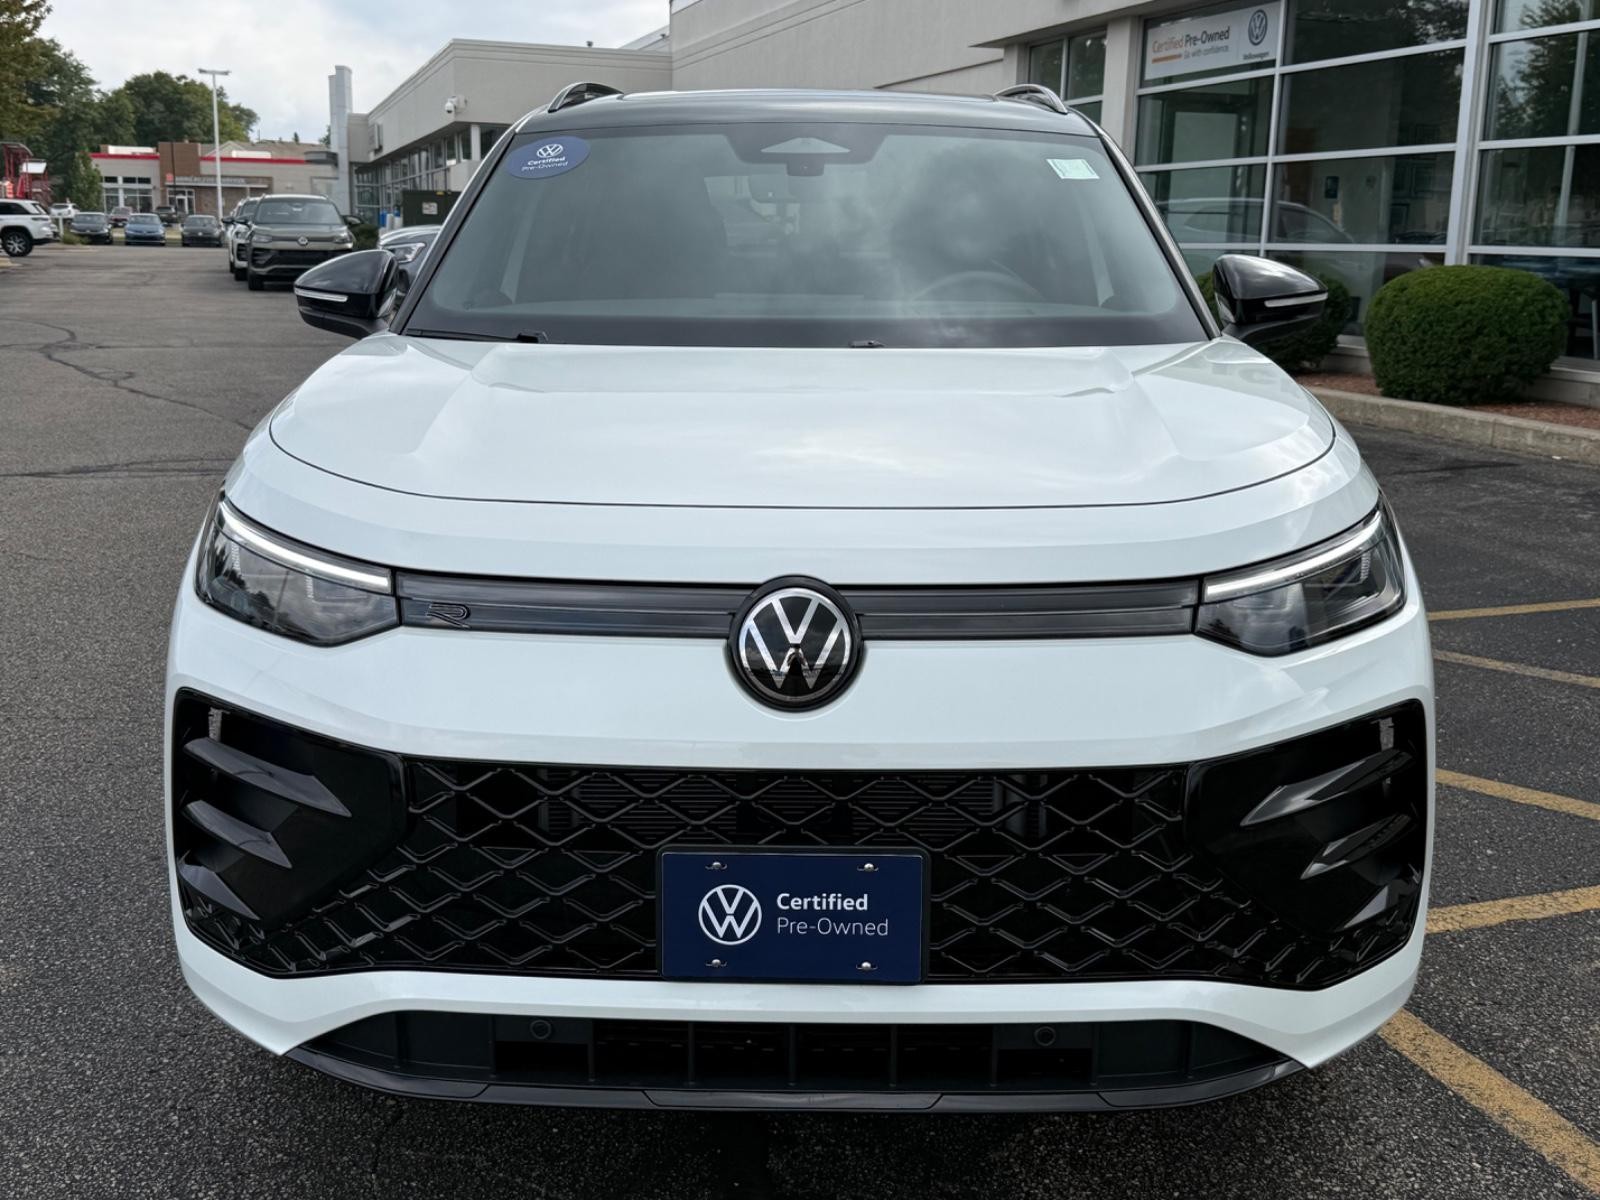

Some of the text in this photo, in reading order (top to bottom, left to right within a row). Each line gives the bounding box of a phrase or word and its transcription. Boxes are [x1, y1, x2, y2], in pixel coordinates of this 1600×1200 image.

[1152, 26, 1230, 54] Certified Pre-Owned
[521, 161, 568, 171] Pre-Owned
[528, 156, 566, 166] Certified
[776, 893, 868, 911] Certified
[776, 917, 889, 936] Pre-Owned
